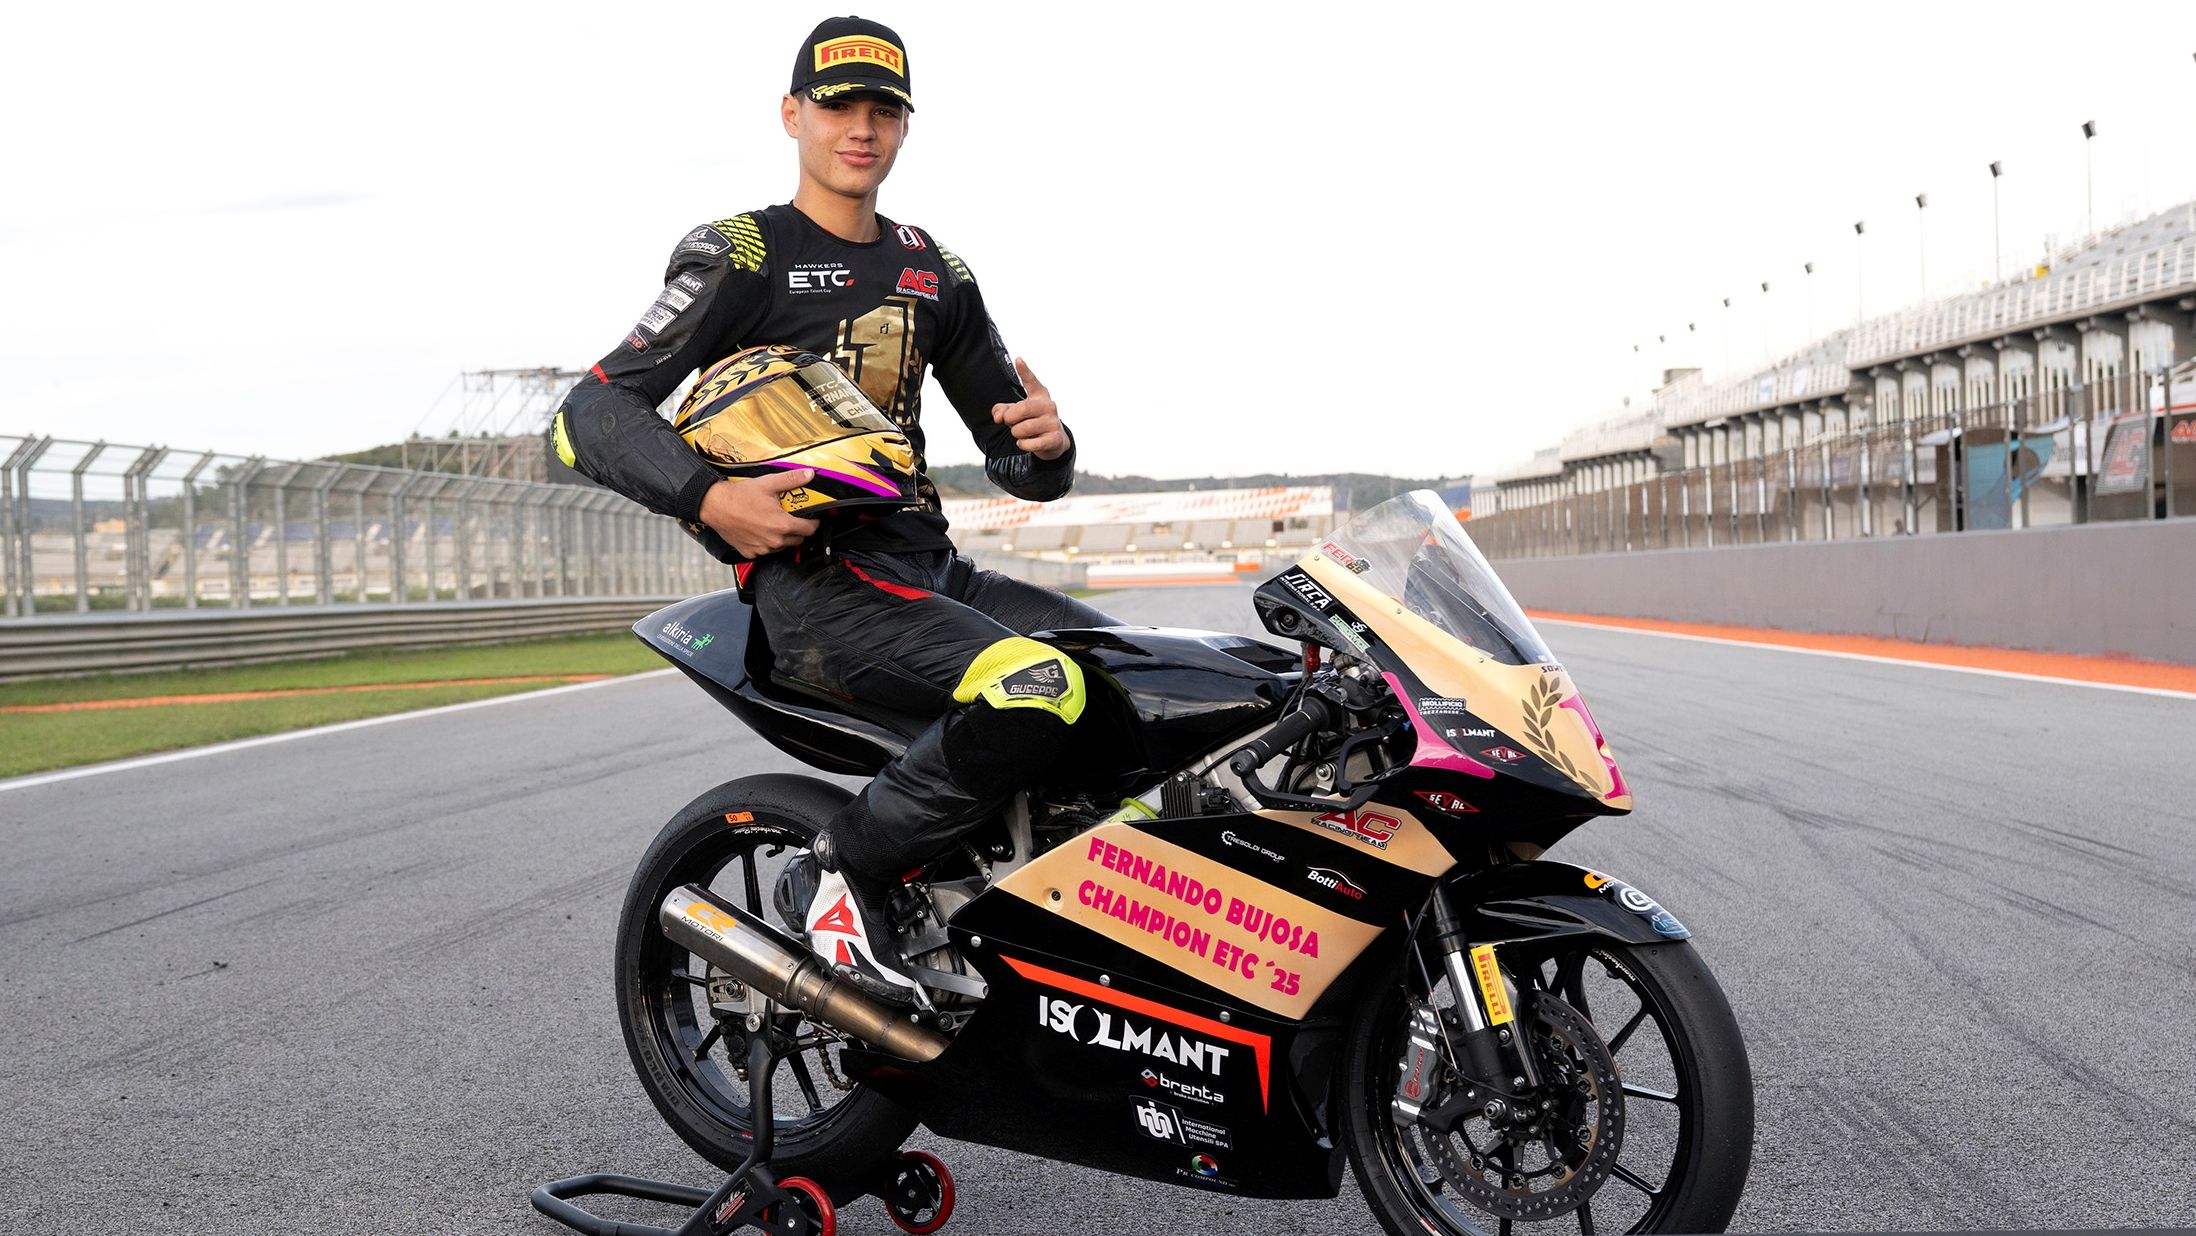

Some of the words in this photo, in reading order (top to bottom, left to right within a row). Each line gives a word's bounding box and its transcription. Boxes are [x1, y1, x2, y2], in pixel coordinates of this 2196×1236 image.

[821, 40, 899, 69] PIRELLI
[788, 269, 851, 288] ETC
[897, 267, 939, 295] AC
[662, 620, 693, 645] alkiria
[1315, 810, 1401, 842] AC
[1226, 834, 1260, 852] TRESOLDI
[1260, 848, 1285, 861] GROUP
[1087, 836, 1222, 915] FERNANDO
[1225, 897, 1319, 959] BUJOSA
[1307, 870, 1363, 900] BottiAuto
[681, 915, 724, 942] MOTORI
[1078, 879, 1211, 958] CHAMPION
[1212, 938, 1260, 980] ETC
[1477, 952, 1507, 1017] PIRELLI
[1160, 1072, 1224, 1103] brenta
[1182, 1118, 1226, 1135] International
[1188, 1133, 1214, 1145] Utensili
[1215, 1140, 1229, 1149] SPA
